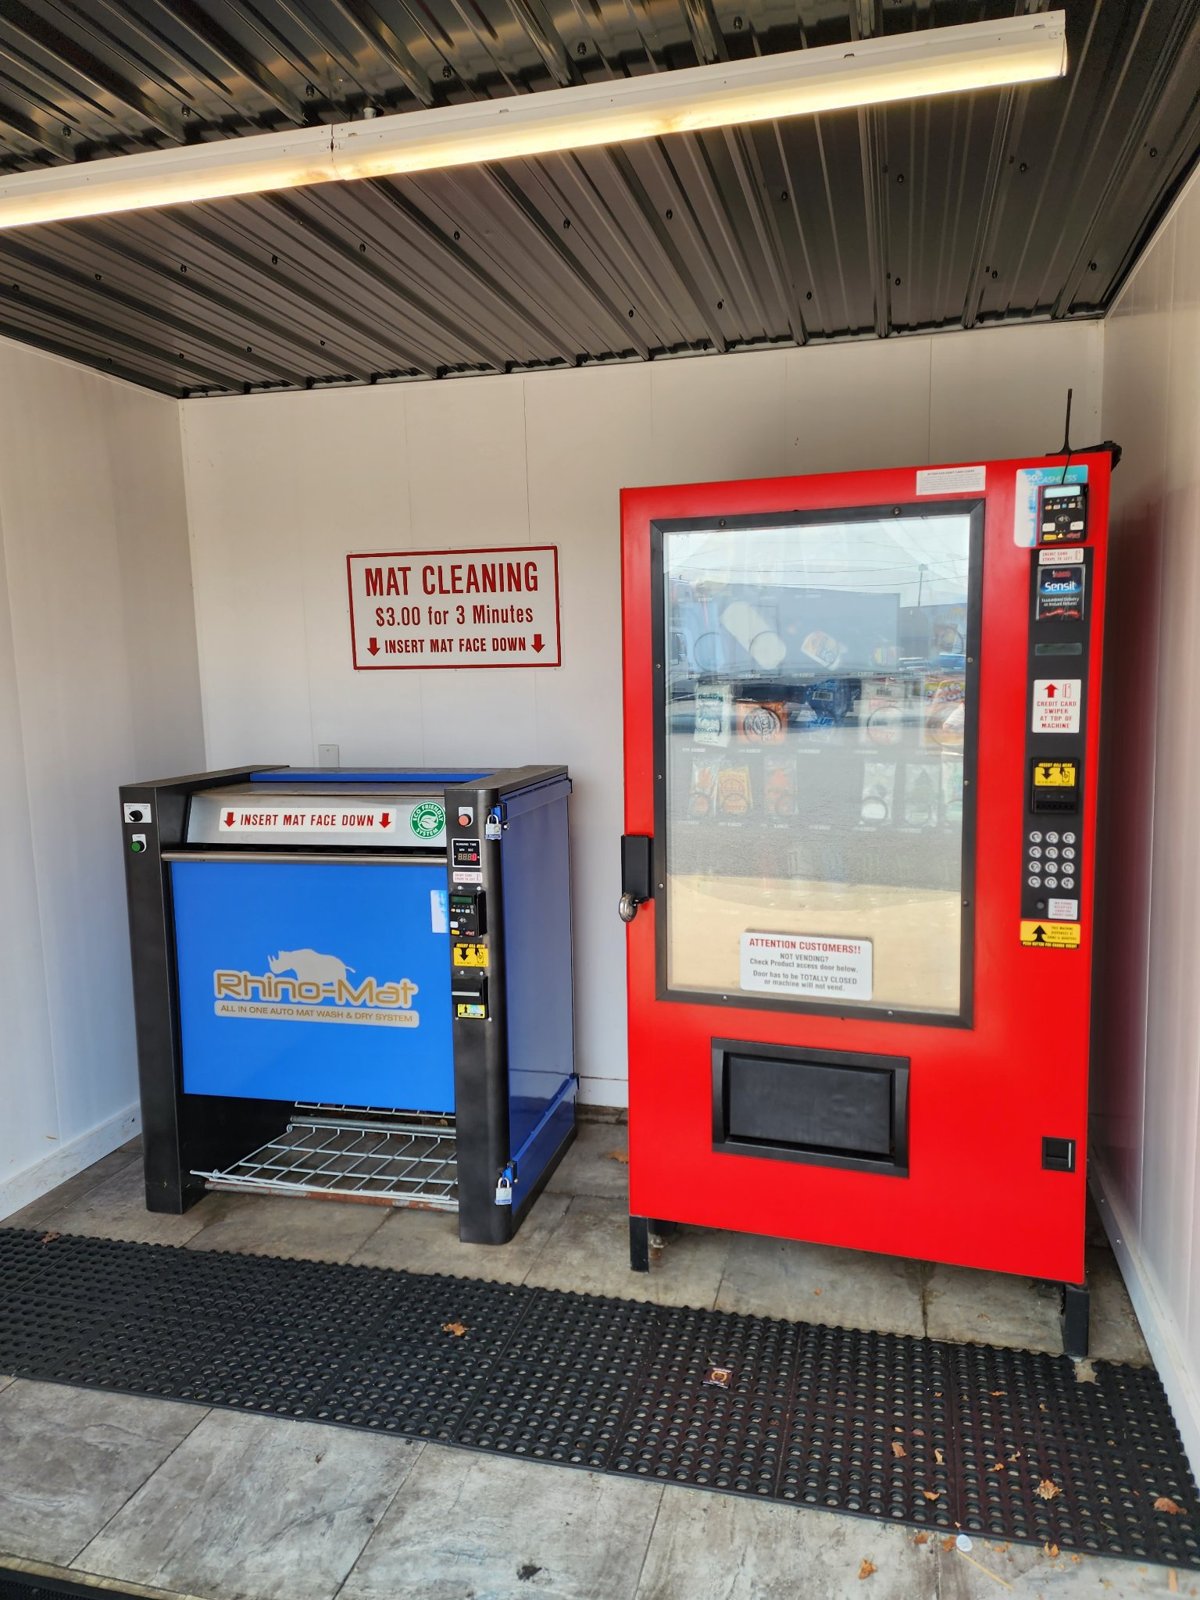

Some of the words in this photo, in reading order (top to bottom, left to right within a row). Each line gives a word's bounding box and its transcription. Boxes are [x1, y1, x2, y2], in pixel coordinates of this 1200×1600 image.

[365, 567, 411, 596] MAT
[422, 561, 538, 594] CLEANING
[1045, 581, 1076, 591] Sensit
[376, 606, 421, 626] $3.00
[428, 606, 449, 625] for
[456, 605, 465, 624] 3
[473, 604, 533, 624] Minutes
[385, 640, 424, 653] INSERT
[430, 639, 453, 652] MAT
[459, 638, 486, 652] FACE
[492, 637, 526, 651] DOWN
[240, 814, 278, 826] INSERT
[283, 814, 306, 826] MAT
[310, 814, 337, 826] FACE
[341, 814, 374, 826] DOWN
[421, 804, 444, 821] FRIENDLY
[416, 828, 438, 836] SYSTEM
[749, 938, 796, 949] ATTENTION
[800, 942, 861, 954] CUSTOMERS!!
[795, 954, 829, 962] VENDING?
[800, 974, 828, 982] TOTALLY
[830, 976, 857, 985] CLOSED
[215, 972, 417, 1006] Rhino-Mat
[221, 1005, 236, 1013] ALL
[249, 1006, 268, 1014] ONE
[270, 1007, 294, 1016] AUTO
[296, 1008, 314, 1016] MAT
[316, 1009, 343, 1019] WASH
[354, 1011, 373, 1020] DRY
[375, 1013, 413, 1022] SYSTEM
